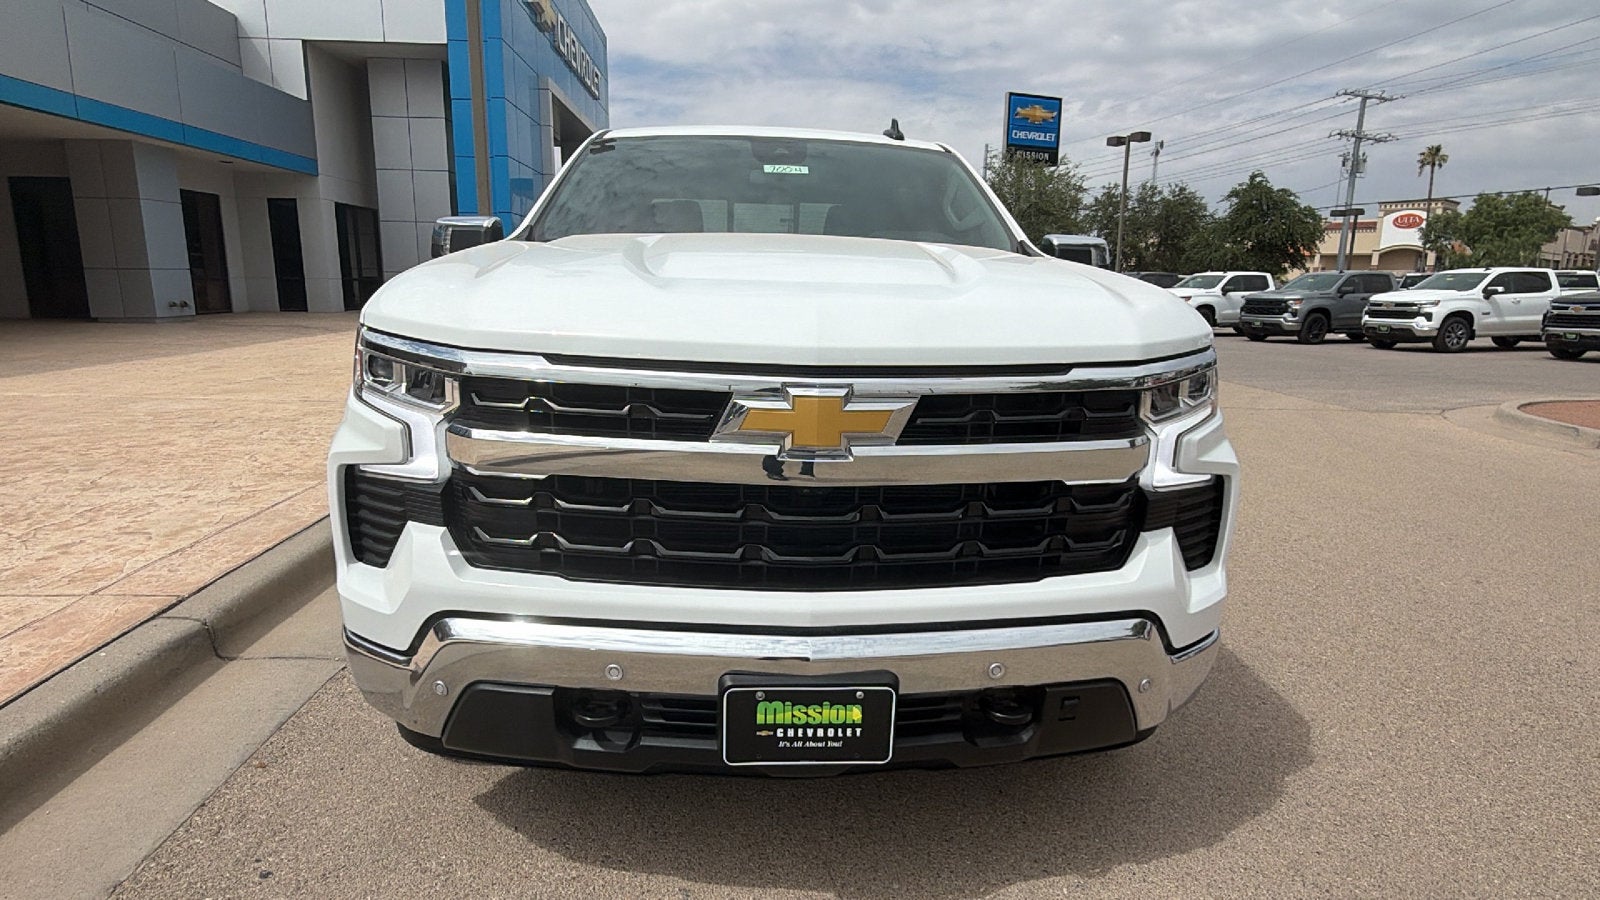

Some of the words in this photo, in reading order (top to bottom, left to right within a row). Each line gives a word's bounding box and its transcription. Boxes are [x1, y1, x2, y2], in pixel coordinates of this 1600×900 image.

[556, 12, 601, 99] CHEVROLET
[1012, 130, 1055, 141] CHEVROLET
[756, 700, 863, 725] Mission
[776, 727, 863, 738] CHEVROLET
[778, 740, 791, 748] It's
[791, 740, 803, 748] All
[803, 740, 826, 748] About
[827, 740, 843, 748] You!
